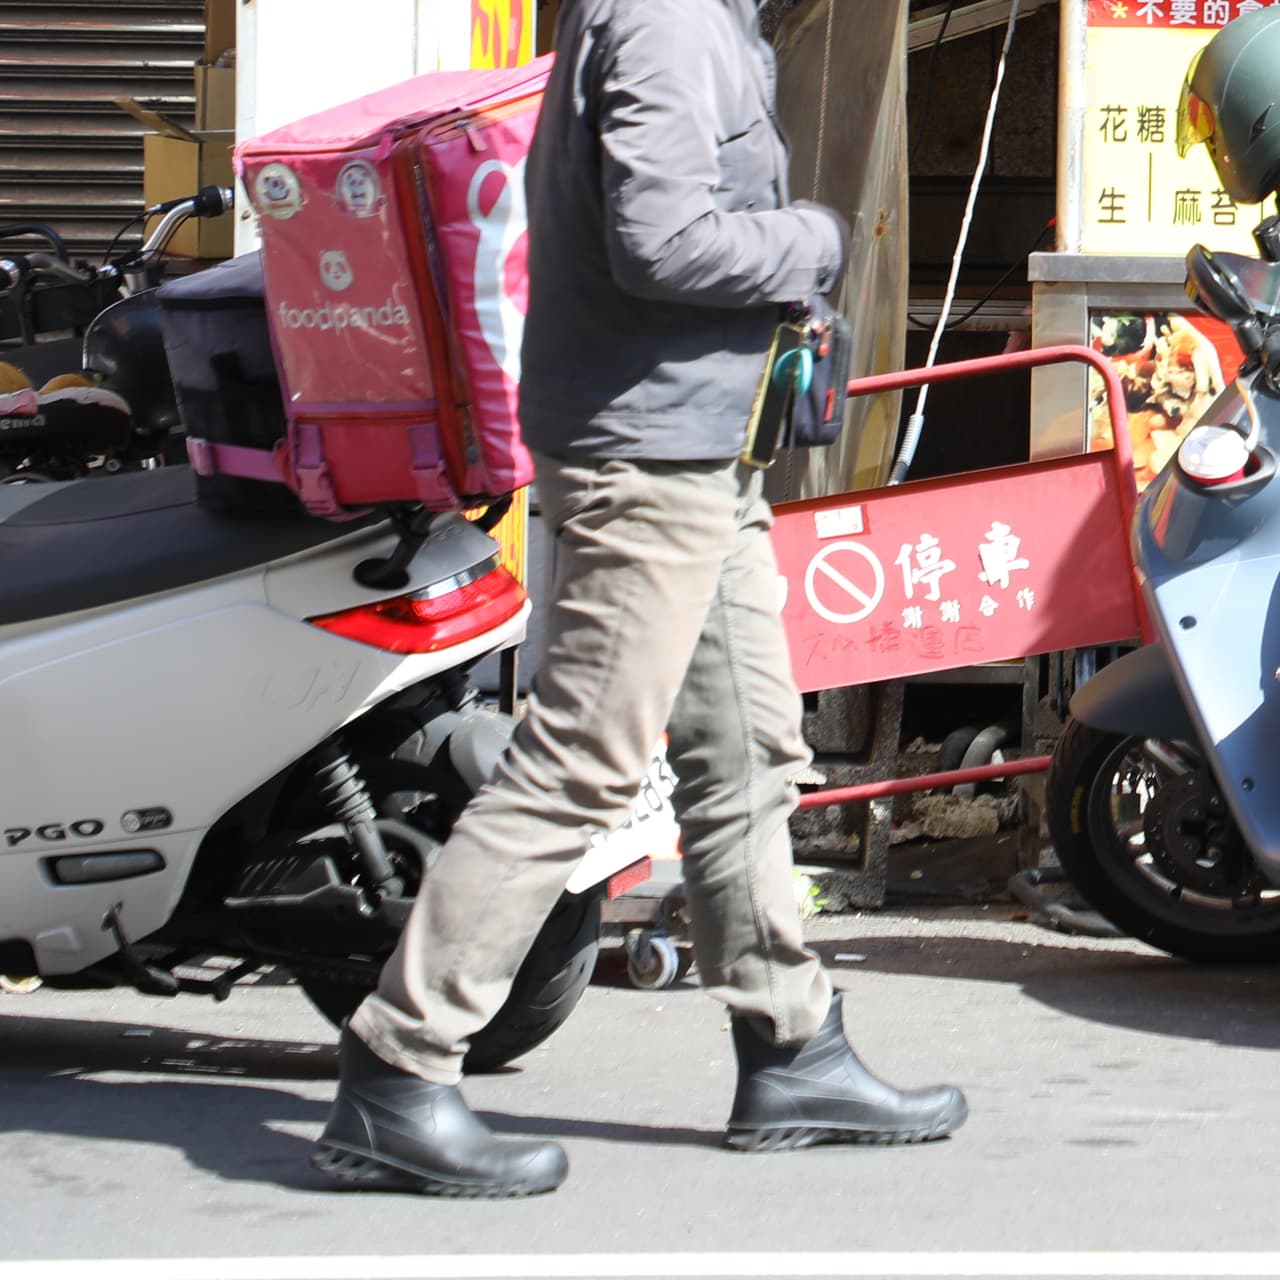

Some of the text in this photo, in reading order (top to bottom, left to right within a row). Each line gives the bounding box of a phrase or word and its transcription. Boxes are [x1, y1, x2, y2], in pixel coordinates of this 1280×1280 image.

[278, 296, 410, 334] foodpanda
[893, 519, 1032, 602] 停車
[900, 586, 1036, 630] 謝謝合作
[3, 819, 105, 848] PGO
